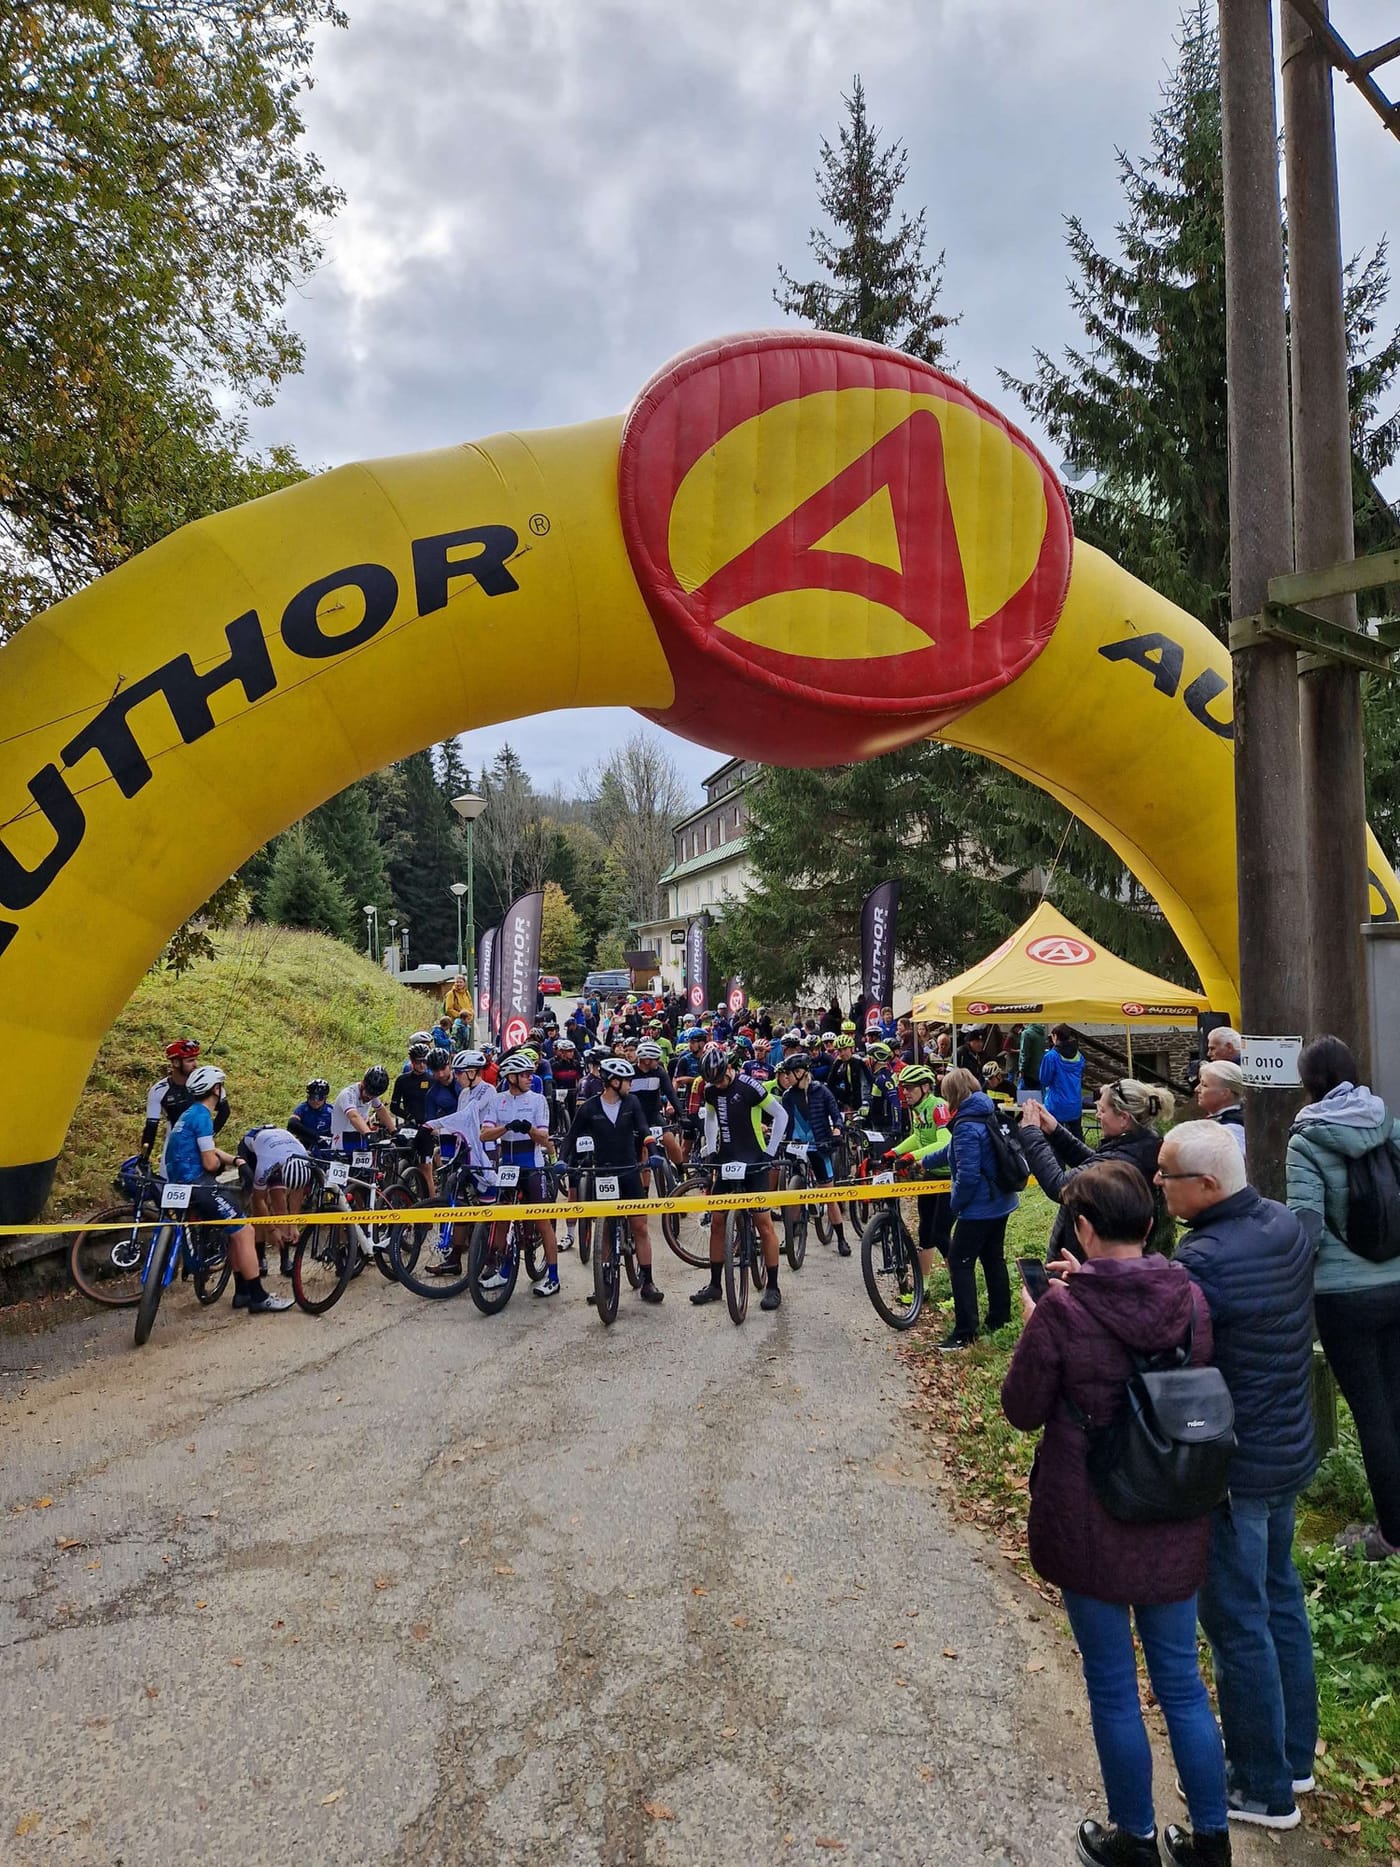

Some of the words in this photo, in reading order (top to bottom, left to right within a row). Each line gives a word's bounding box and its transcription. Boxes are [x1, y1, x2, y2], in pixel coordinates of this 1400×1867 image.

[0, 525, 519, 956] UTHOR
[871, 907, 884, 1002] AUTHOR
[512, 917, 526, 1013] AUTHOR
[1256, 1057, 1284, 1068] 0110
[725, 1165, 742, 1173] 057
[500, 1172, 516, 1181] 039
[599, 1184, 616, 1193] 059
[167, 1191, 185, 1201] 058
[799, 1191, 846, 1199] AUTHOR
[616, 1202, 662, 1210] AUTHOR
[525, 1207, 571, 1215] AUTHOR
